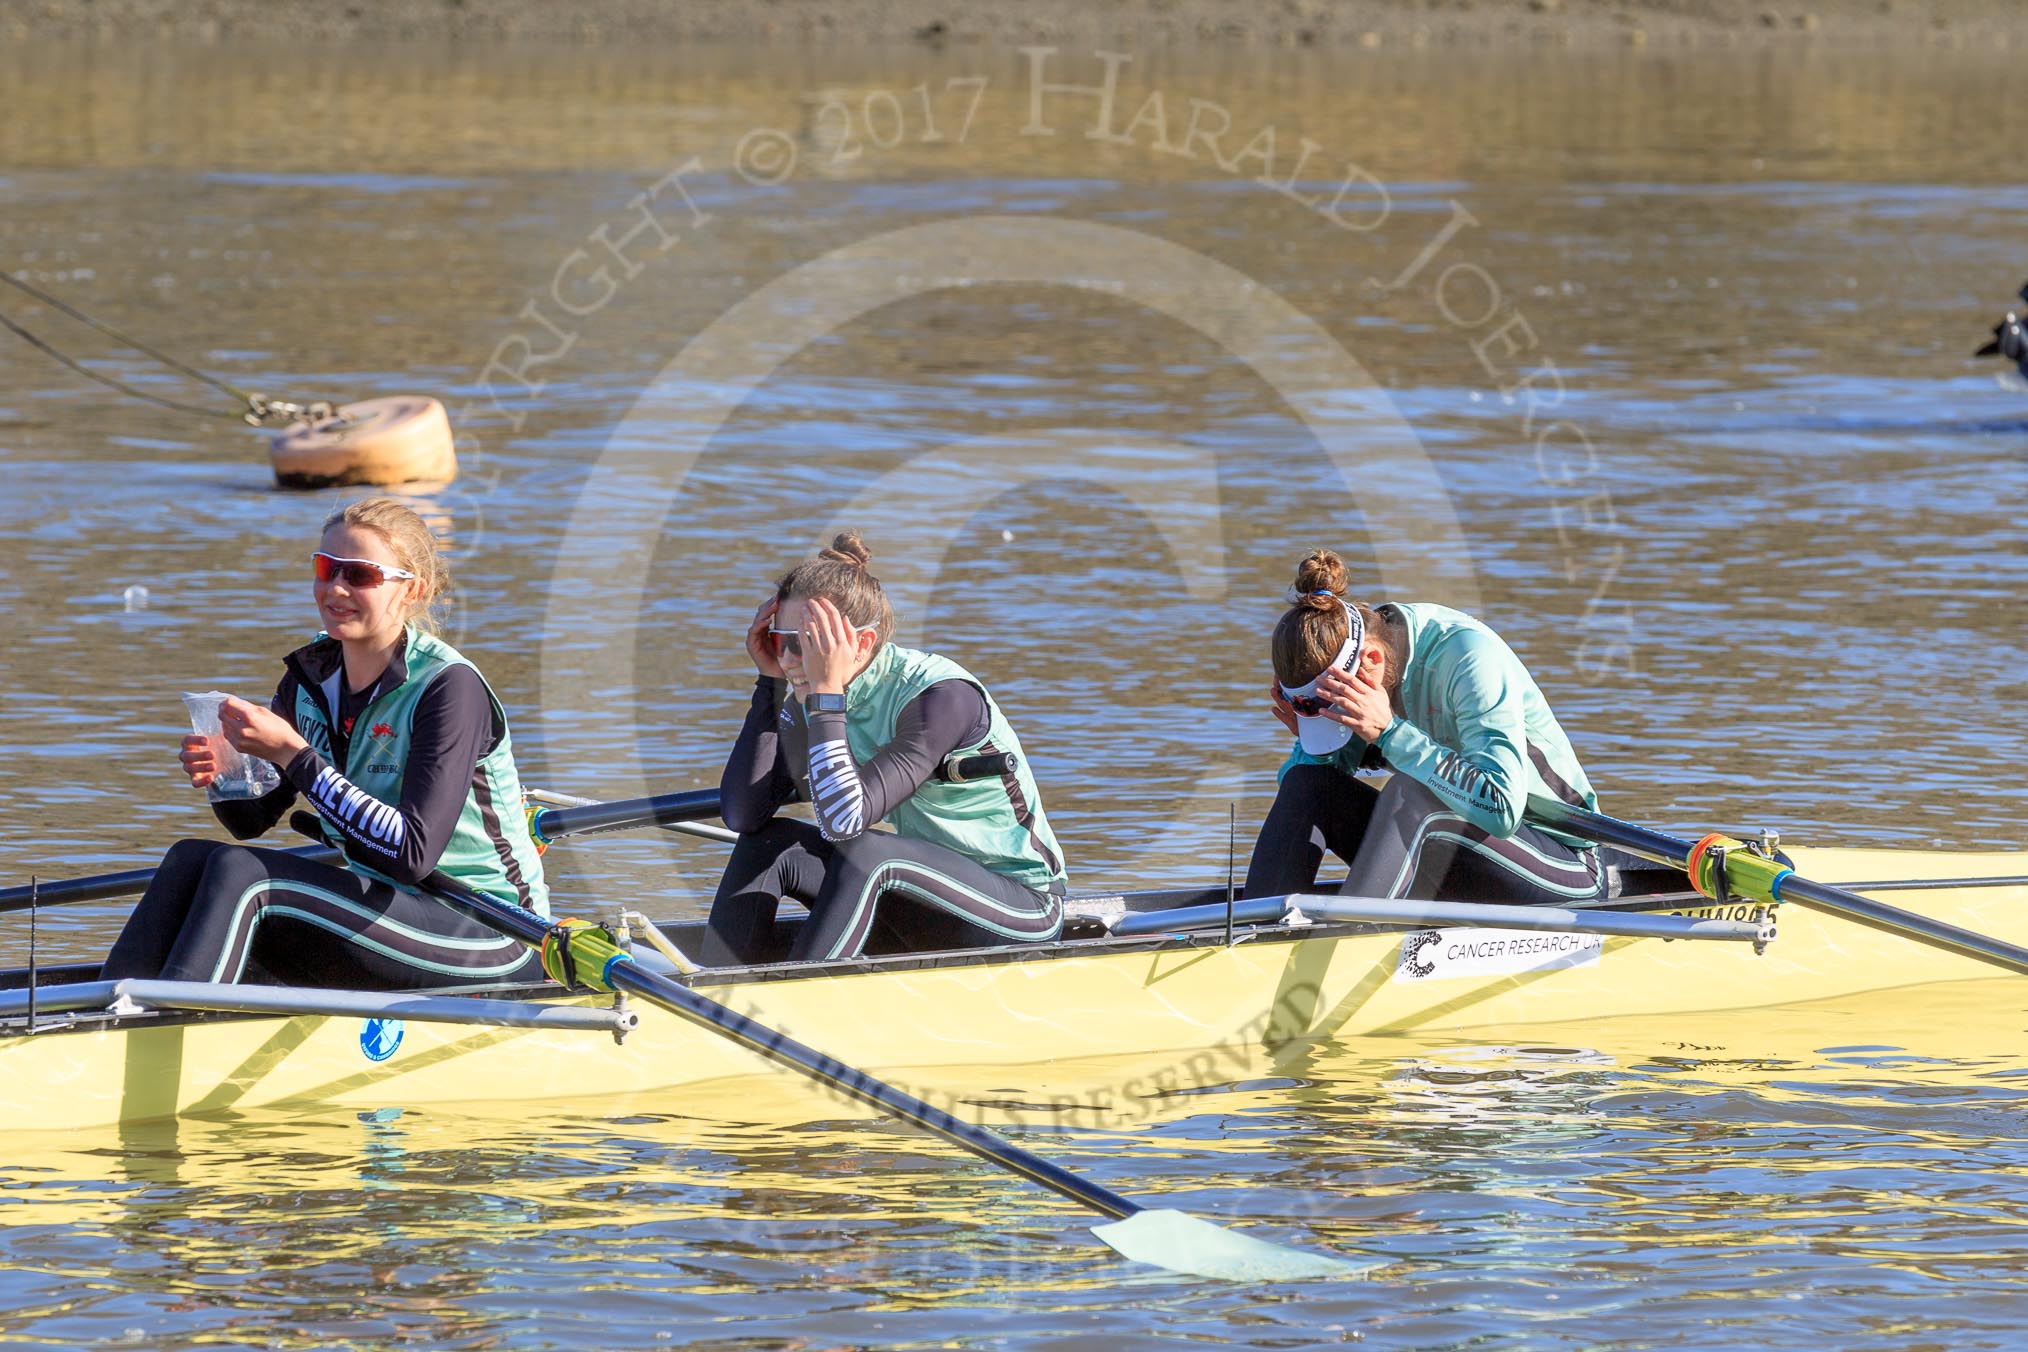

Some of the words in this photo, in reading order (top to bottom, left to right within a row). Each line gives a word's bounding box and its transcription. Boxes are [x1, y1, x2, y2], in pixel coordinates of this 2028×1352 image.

[310, 765, 404, 847] NEWTON
[1427, 776, 1466, 803] Investment
[307, 793, 346, 829] Investment
[346, 825, 399, 859] Management
[1447, 940, 1506, 961] CANCER
[1509, 935, 1581, 956] RESEARCH
